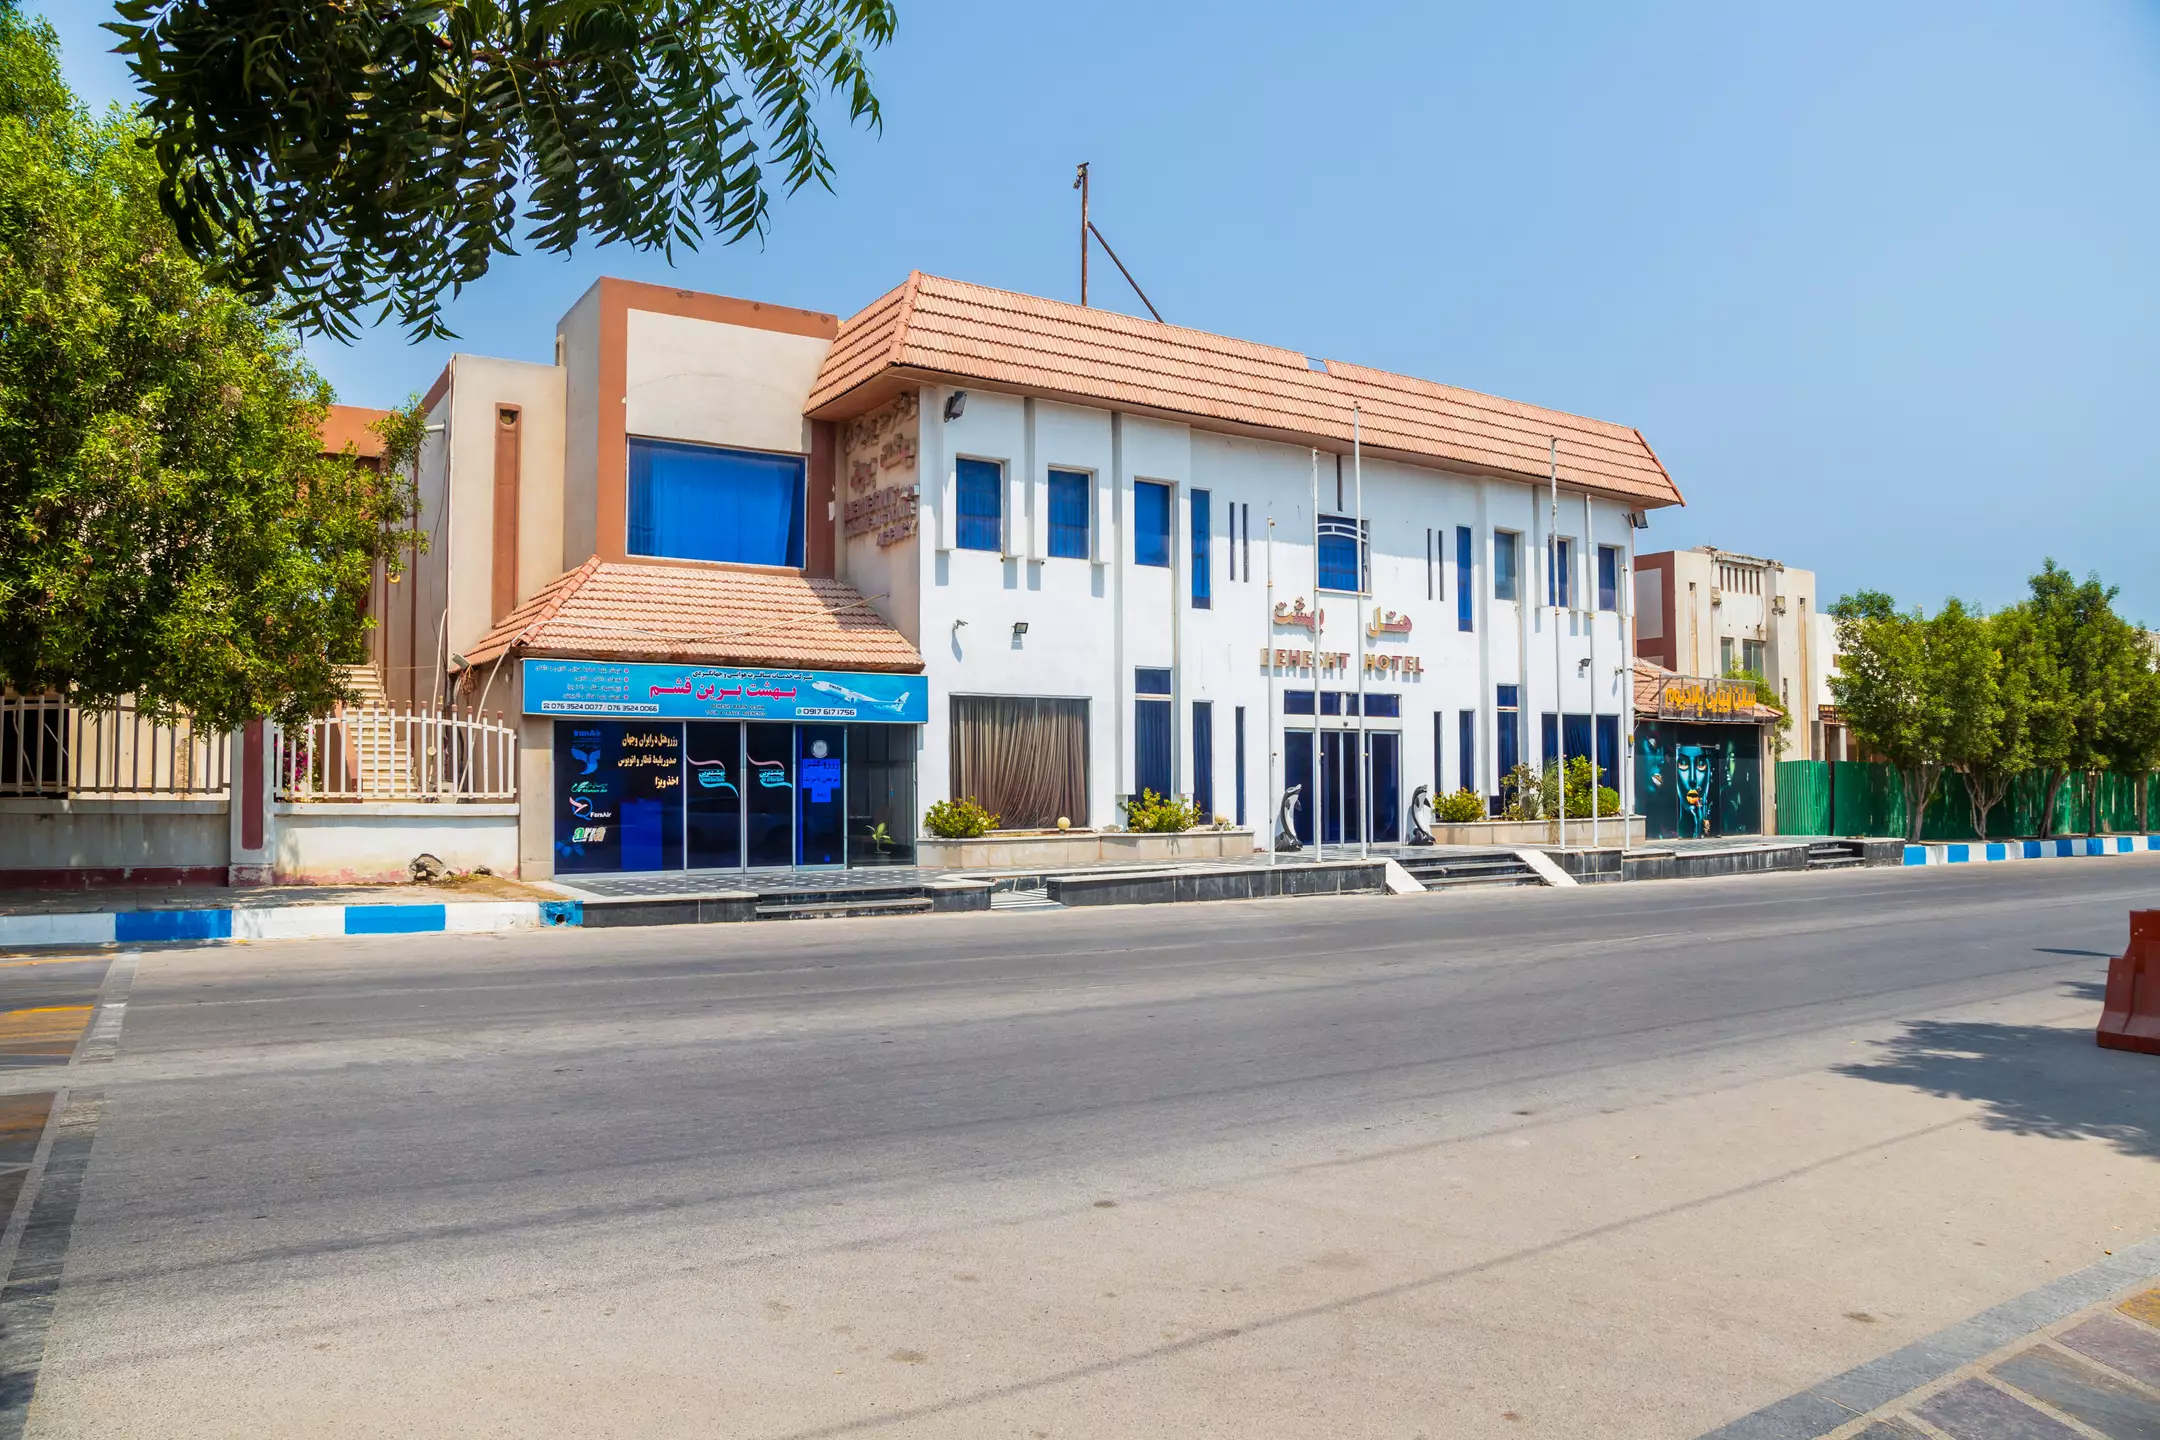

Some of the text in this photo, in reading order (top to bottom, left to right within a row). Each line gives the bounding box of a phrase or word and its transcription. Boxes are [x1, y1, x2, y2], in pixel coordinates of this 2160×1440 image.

[1366, 606, 1412, 638] هتل
[1364, 653, 1424, 673] HOTEL
[649, 677, 797, 702] بهشت برین قشم
[567, 703, 585, 711] 3524
[608, 703, 621, 711] 076
[640, 704, 658, 712] 0066
[655, 775, 679, 788] اخذ ویزا
